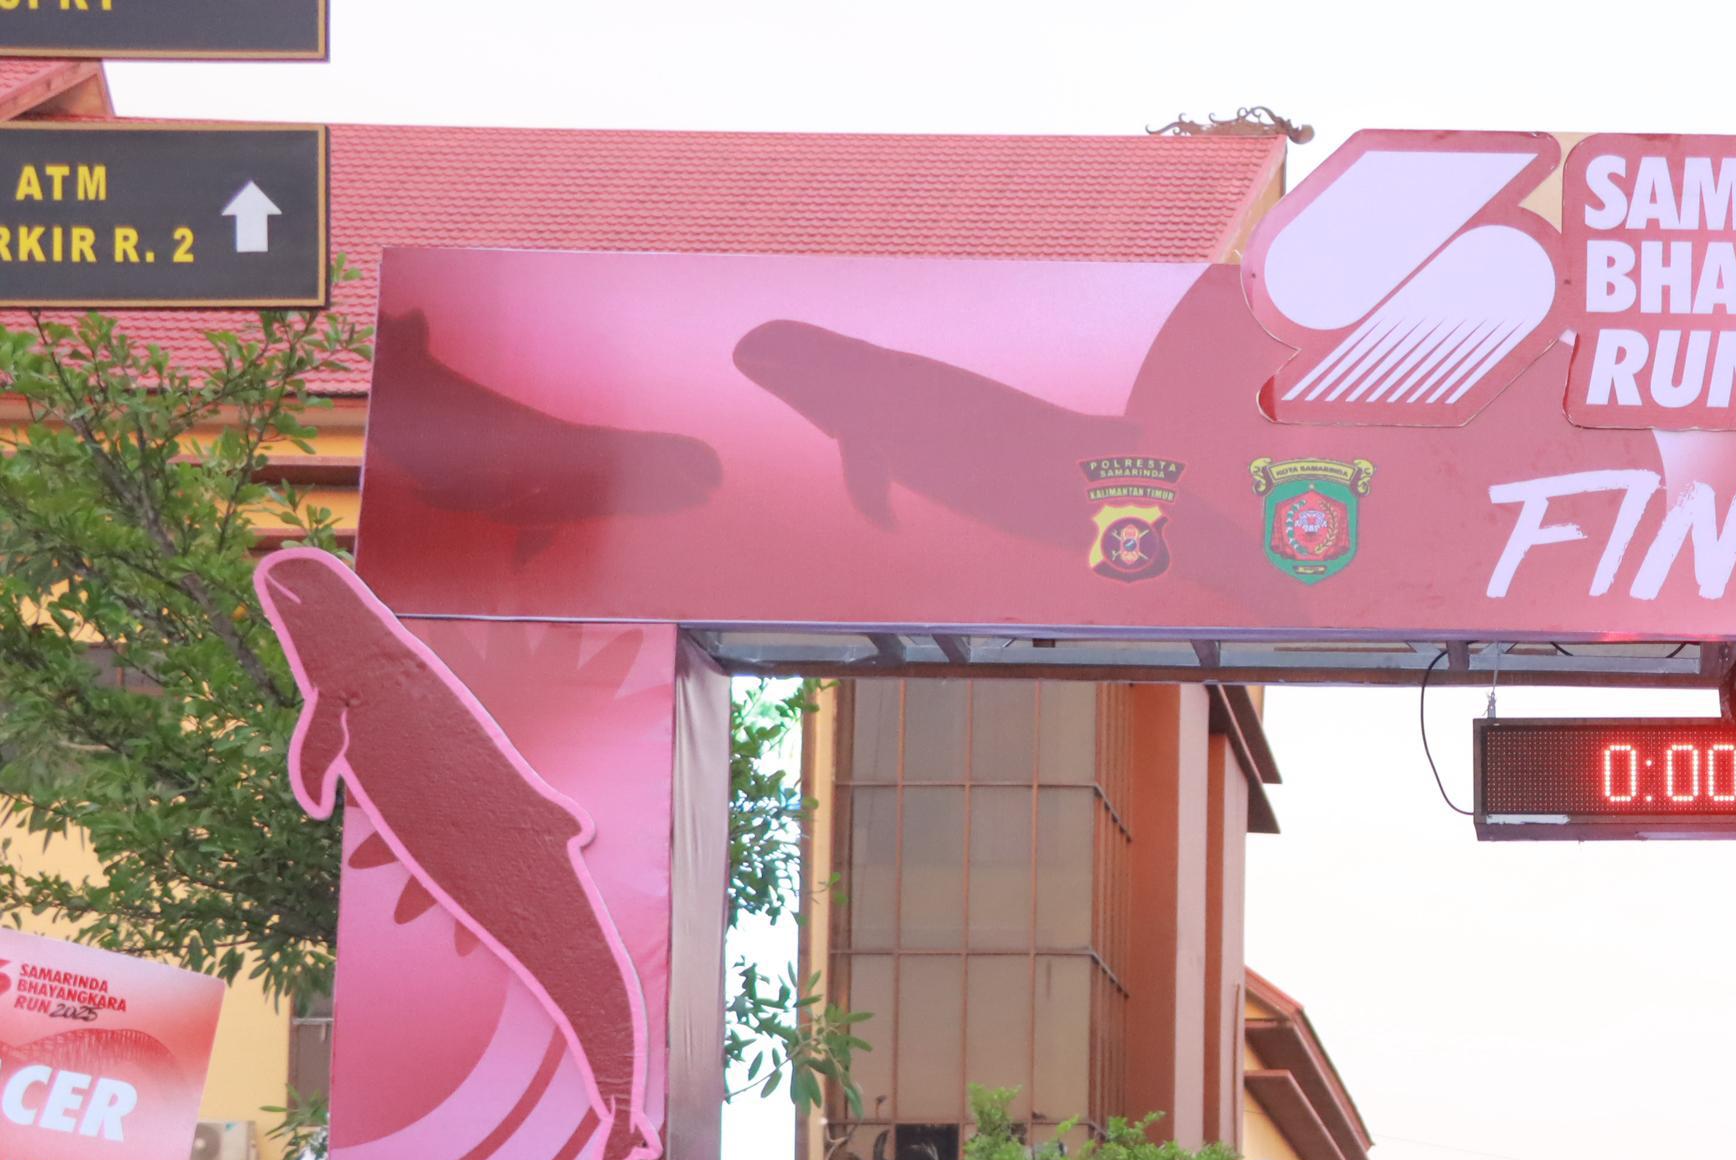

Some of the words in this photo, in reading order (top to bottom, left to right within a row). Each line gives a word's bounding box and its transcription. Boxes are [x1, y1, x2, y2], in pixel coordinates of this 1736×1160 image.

[15, 165, 107, 200] ATM
[114, 227, 155, 263] R.
[172, 227, 195, 263] 2
[1089, 458, 1177, 472] POLRESTA
[1089, 488, 1144, 500] KALIMANTAN
[1147, 488, 1175, 502] TIMUR
[19, 963, 109, 994] SAMARINDA
[14, 994, 51, 1017] RUN
[48, 1002, 99, 1022] 2025
[16, 977, 127, 1012] BHAYANGKARA
